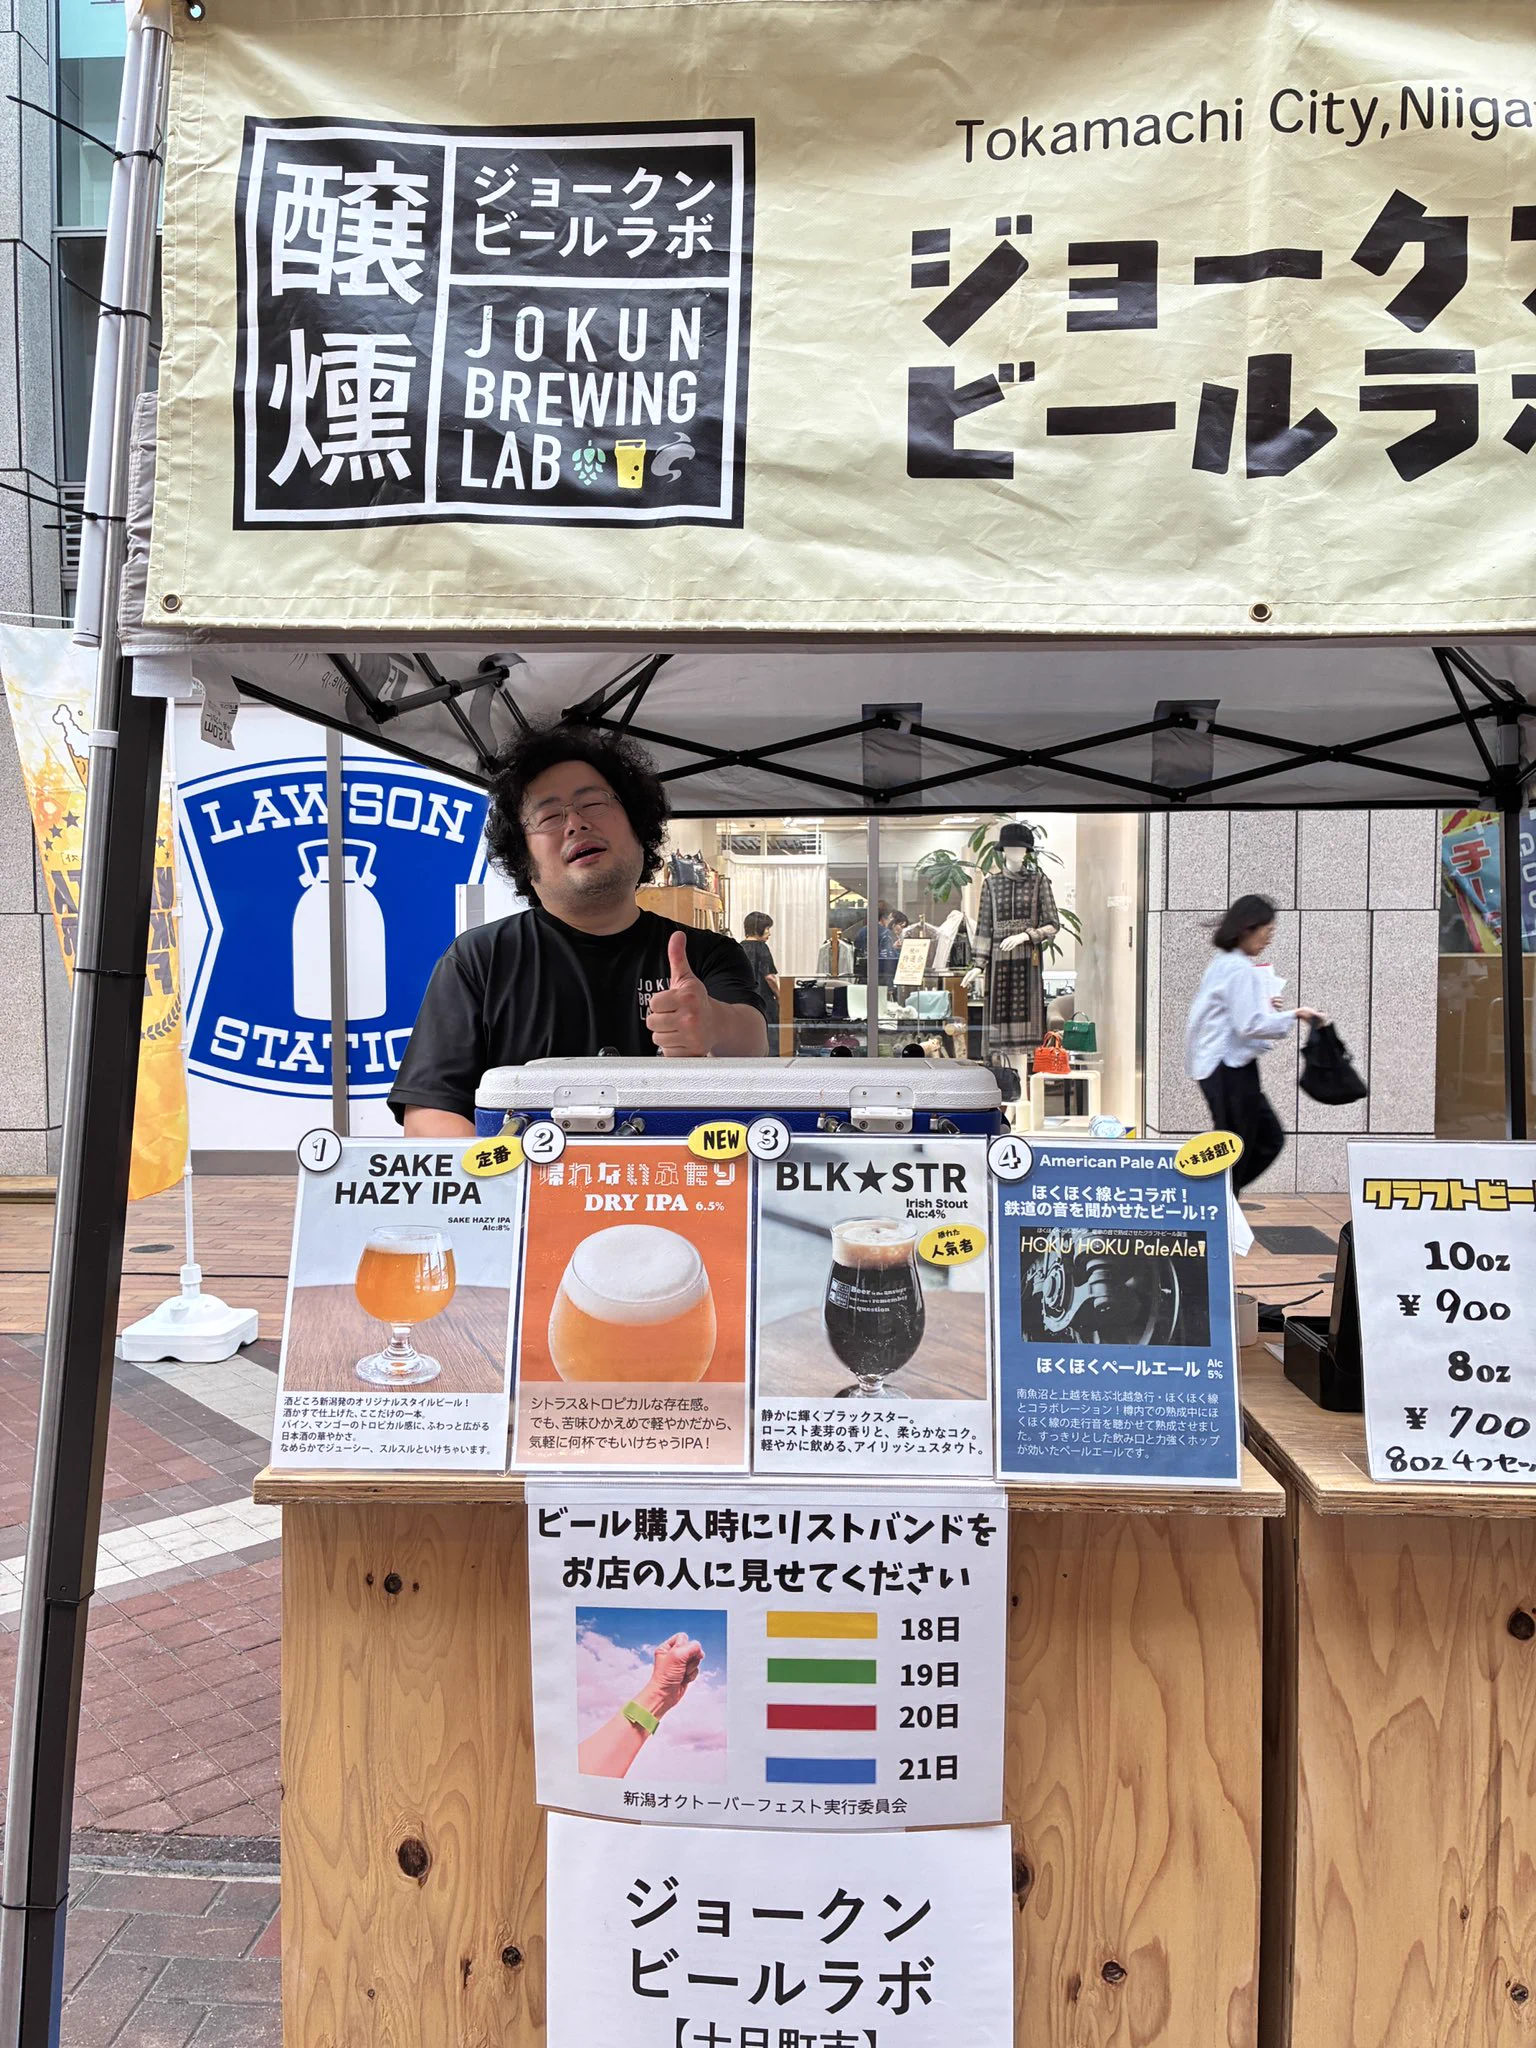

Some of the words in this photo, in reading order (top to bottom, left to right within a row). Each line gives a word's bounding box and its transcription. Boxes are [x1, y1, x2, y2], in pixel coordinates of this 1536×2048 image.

[955, 97, 1243, 164] Tokamachi
[1269, 85, 1536, 149] City,Niiga
[473, 162, 716, 210] ジョークン
[473, 211, 715, 260] ビールラボ
[910, 189, 1536, 348] ジョーク
[464, 304, 701, 364] JOKUN
[463, 368, 699, 428] BREWING
[461, 431, 563, 491] LAB
[201, 782, 474, 845] LAWSON
[637, 977, 671, 993] JOK
[311, 1137, 327, 1162] 1
[531, 1128, 554, 1153] 2
[703, 1129, 740, 1151] NEW
[757, 1125, 779, 1151] 3
[368, 1153, 454, 1177] SAKE
[475, 1145, 512, 1169] 定番
[998, 1144, 1021, 1170] 4
[1039, 1154, 1117, 1169] American
[1120, 1155, 1155, 1169] Pale
[1157, 1156, 1177, 1170] Al
[334, 1181, 423, 1205] HAZY
[431, 1181, 482, 1205] IPA
[584, 1194, 640, 1212] DRY
[644, 1194, 689, 1212] IPA
[695, 1201, 725, 1212] 6.5%
[906, 1198, 933, 1209] Irish
[935, 1198, 969, 1209] Stout
[1363, 1178, 1536, 1212] クラフトビー
[906, 1209, 946, 1219] Alc:4%
[931, 1238, 974, 1259] 人気者
[1020, 1236, 1073, 1254] HOKU
[1078, 1237, 1130, 1256] HOKU
[1424, 1240, 1511, 1272] 10oz
[1436, 1289, 1511, 1323] 900
[1036, 1357, 1201, 1378] ほくほくペールエール
[1207, 1358, 1224, 1368] Alc
[1208, 1369, 1224, 1380] 5%
[1448, 1350, 1511, 1383] 8oz
[1450, 1405, 1531, 1439] 700
[537, 1506, 998, 1547] ビール購入時にリストバンドを
[562, 1555, 971, 1597] お店の人に見せてください
[900, 1616, 960, 1643] 18日
[900, 1662, 960, 1688] 19日
[899, 1704, 960, 1730] 20日
[899, 1755, 959, 1781] 21日
[623, 1790, 908, 1816] 新潟オクトーバーフェスト実行委員会
[625, 1875, 932, 1944] ジョークン
[631, 1947, 935, 2016] ビールラボ
